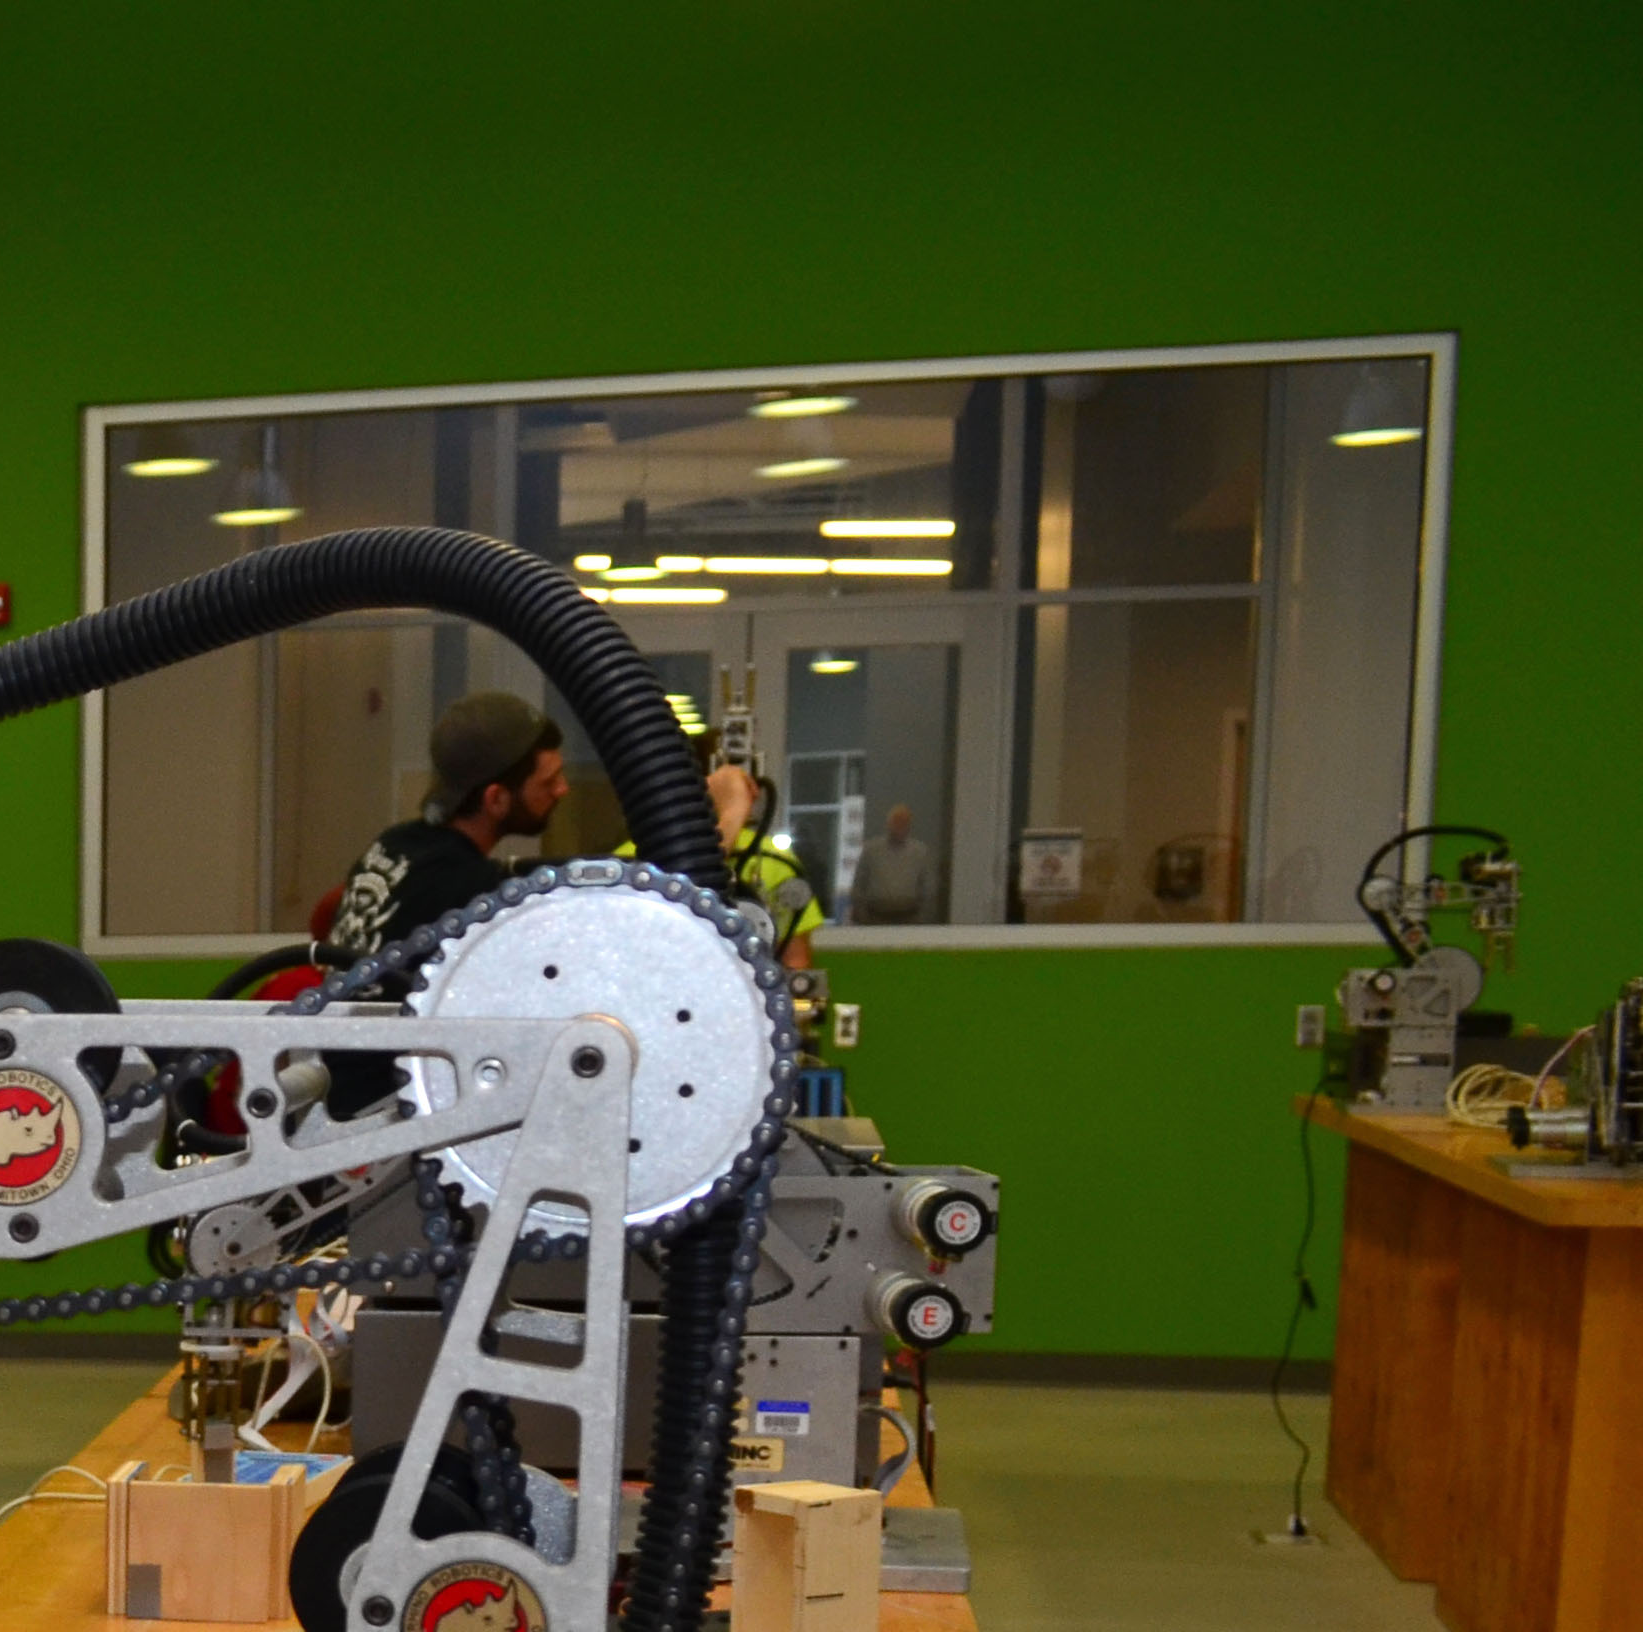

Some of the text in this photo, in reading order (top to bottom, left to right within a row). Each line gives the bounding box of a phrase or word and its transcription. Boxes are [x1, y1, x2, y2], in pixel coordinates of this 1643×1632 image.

[53, 1147, 76, 1180] OHIO
[949, 1211, 967, 1233] C
[922, 1306, 939, 1326] E
[407, 1565, 505, 1632] RHINO ROBOTICS
